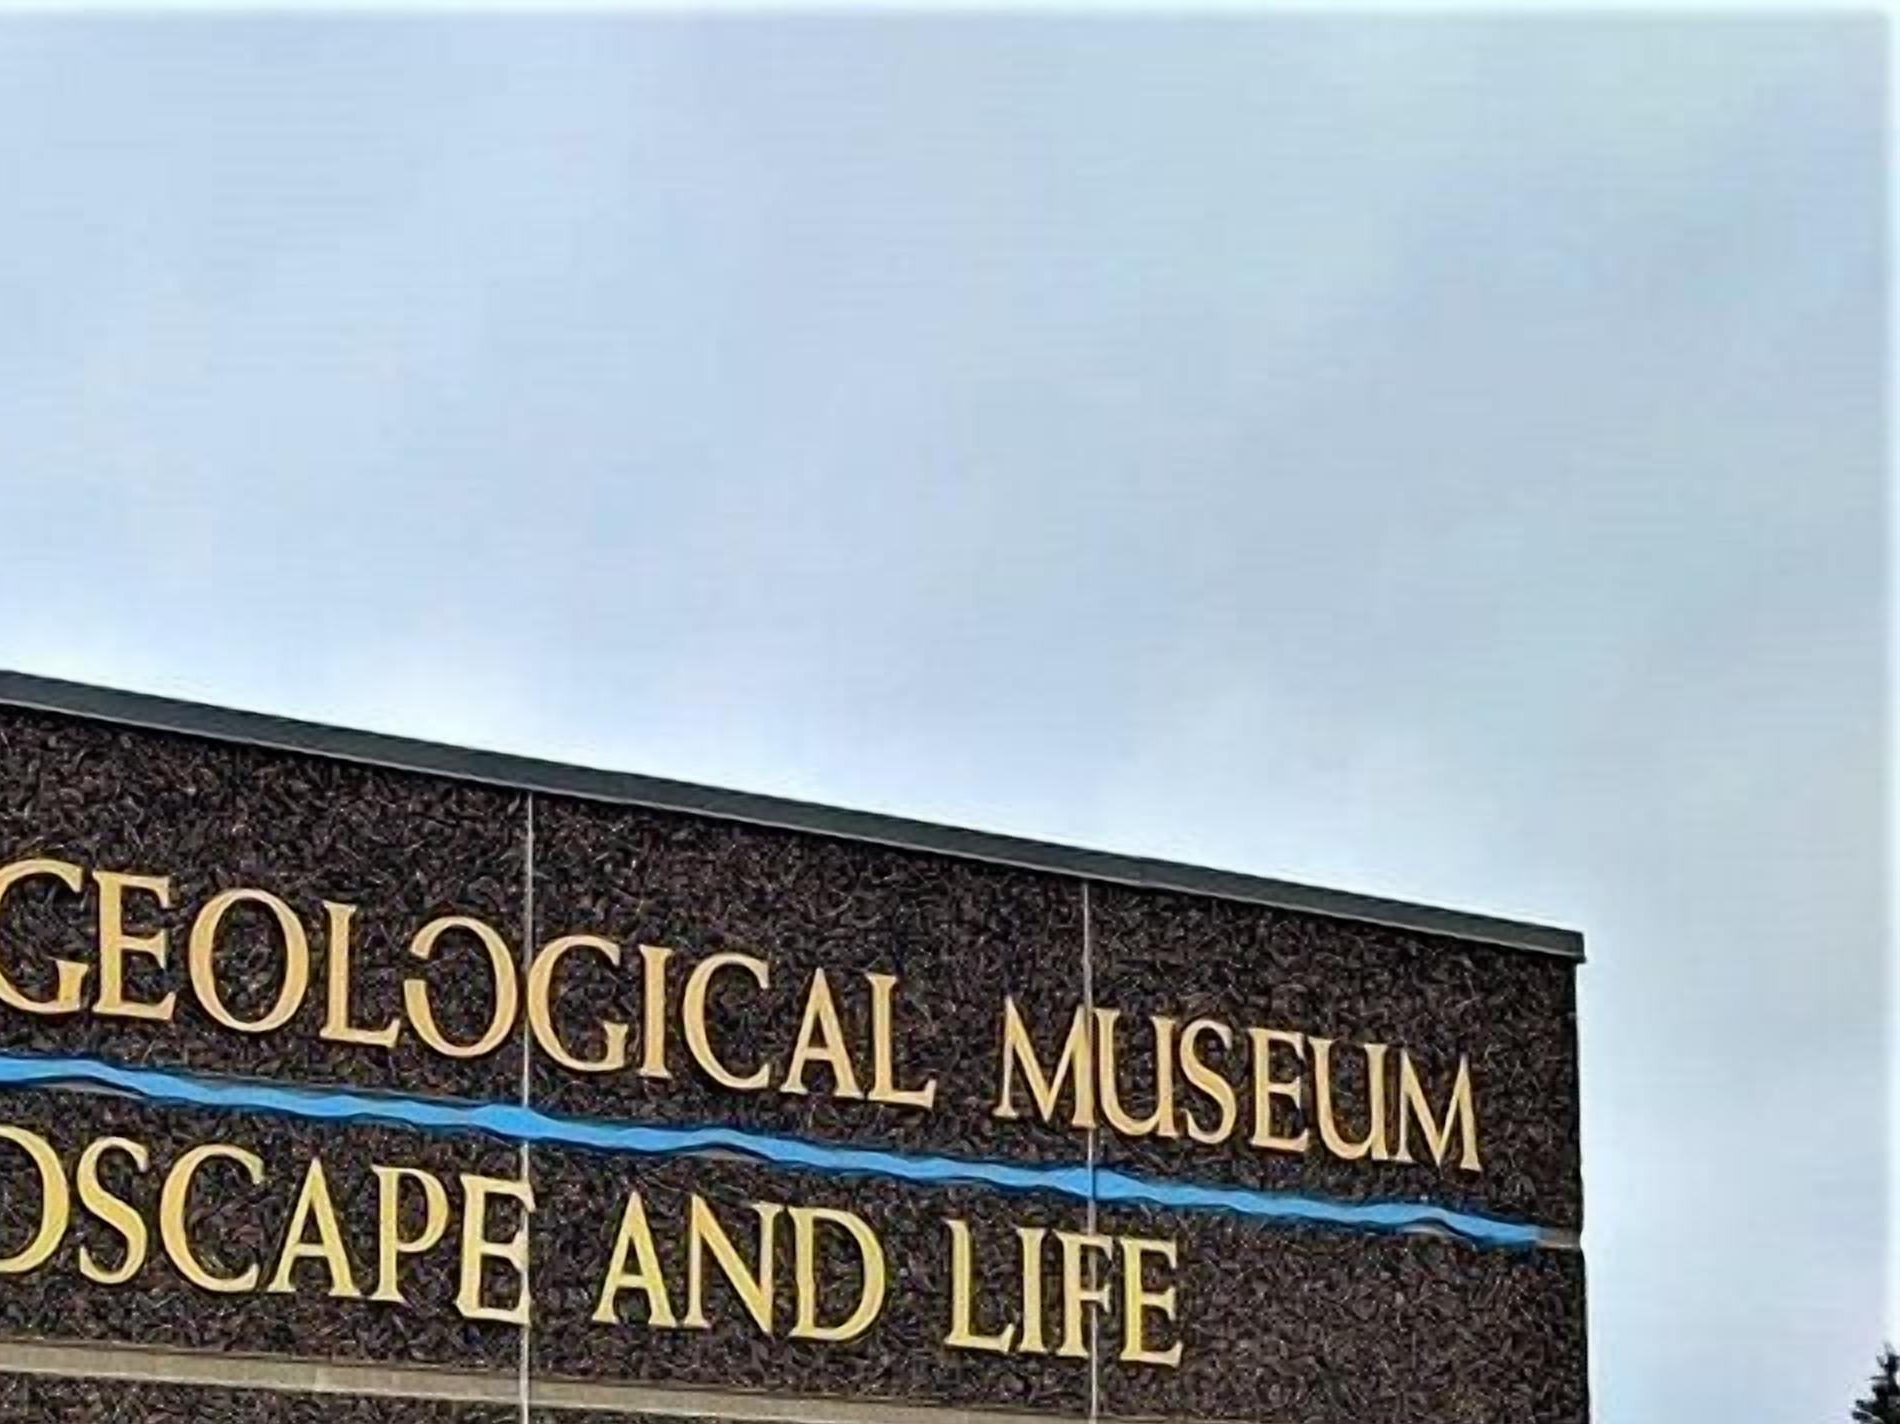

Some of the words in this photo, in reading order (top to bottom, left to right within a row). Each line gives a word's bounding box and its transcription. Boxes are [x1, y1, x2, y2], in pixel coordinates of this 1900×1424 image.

[993, 995, 1484, 1173] MUSEUM
[591, 1190, 888, 1342] AND
[945, 1217, 1184, 1368] LIFE
